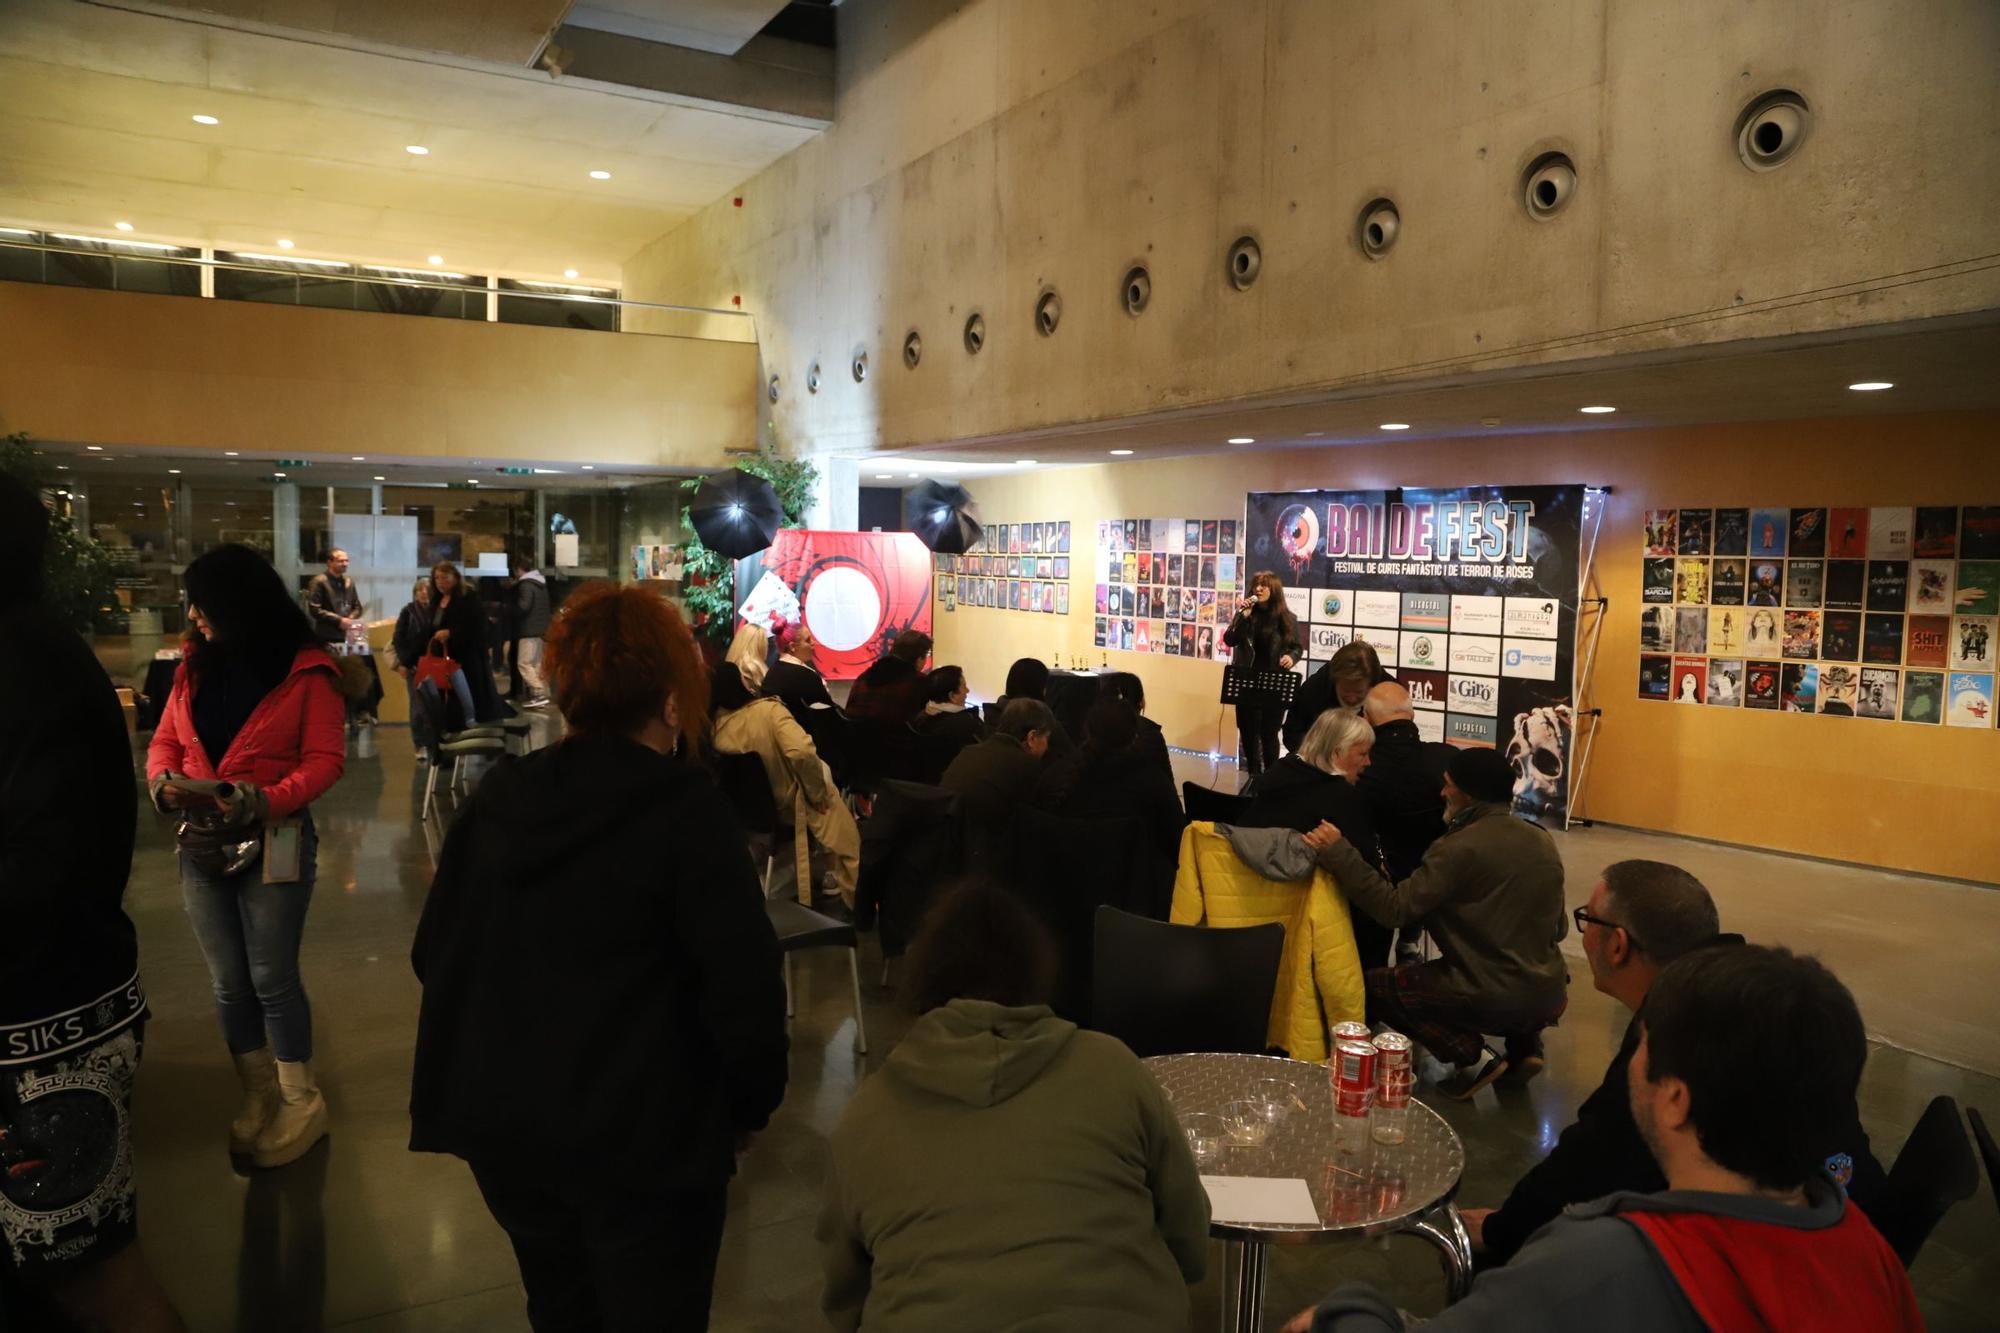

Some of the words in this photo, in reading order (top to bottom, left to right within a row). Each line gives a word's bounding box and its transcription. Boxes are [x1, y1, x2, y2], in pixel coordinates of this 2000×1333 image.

[1334, 561, 1365, 573] FESTIVAL
[1367, 562, 1376, 574] DE
[1377, 562, 1400, 574] CURTS
[1401, 562, 1443, 576] FANTÀSTIC
[1448, 565, 1458, 576] DE
[1460, 565, 1491, 577] TERROR
[1493, 565, 1504, 578] DE
[1506, 566, 1534, 579] ROSES
[1318, 630, 1346, 648] Giró
[1458, 680, 1491, 701] Giró
[9, 1017, 83, 1055] SIKS
